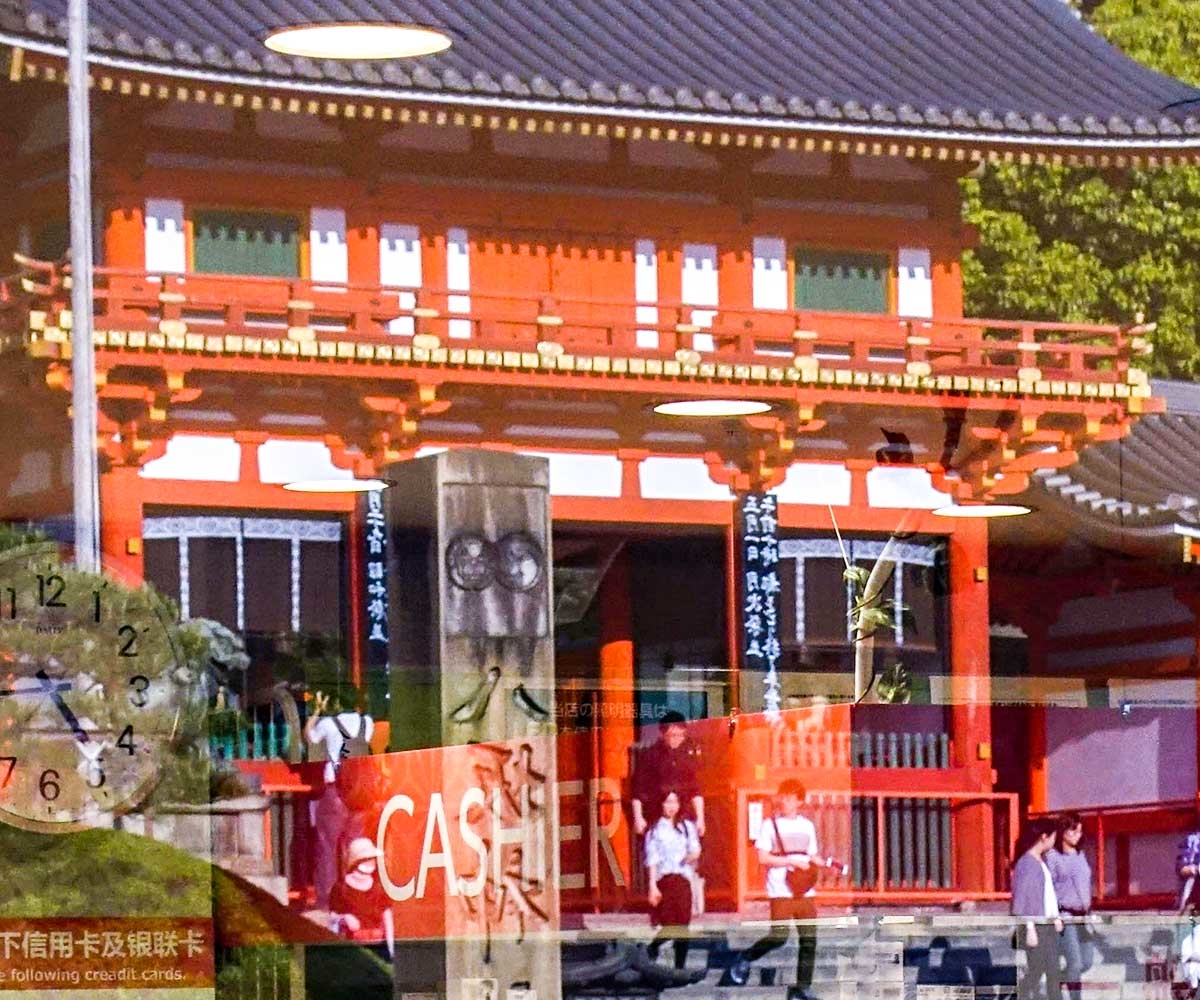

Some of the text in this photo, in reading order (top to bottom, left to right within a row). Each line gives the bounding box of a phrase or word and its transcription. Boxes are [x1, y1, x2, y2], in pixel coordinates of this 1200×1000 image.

[36, 574, 67, 608] 12
[117, 625, 139, 657] 2
[129, 674, 150, 708] 3
[116, 724, 138, 756] 4
[39, 768, 61, 801] 6
[11, 968, 80, 984] following
[85, 967, 137, 981] creadit
[141, 967, 186, 981] cards.
